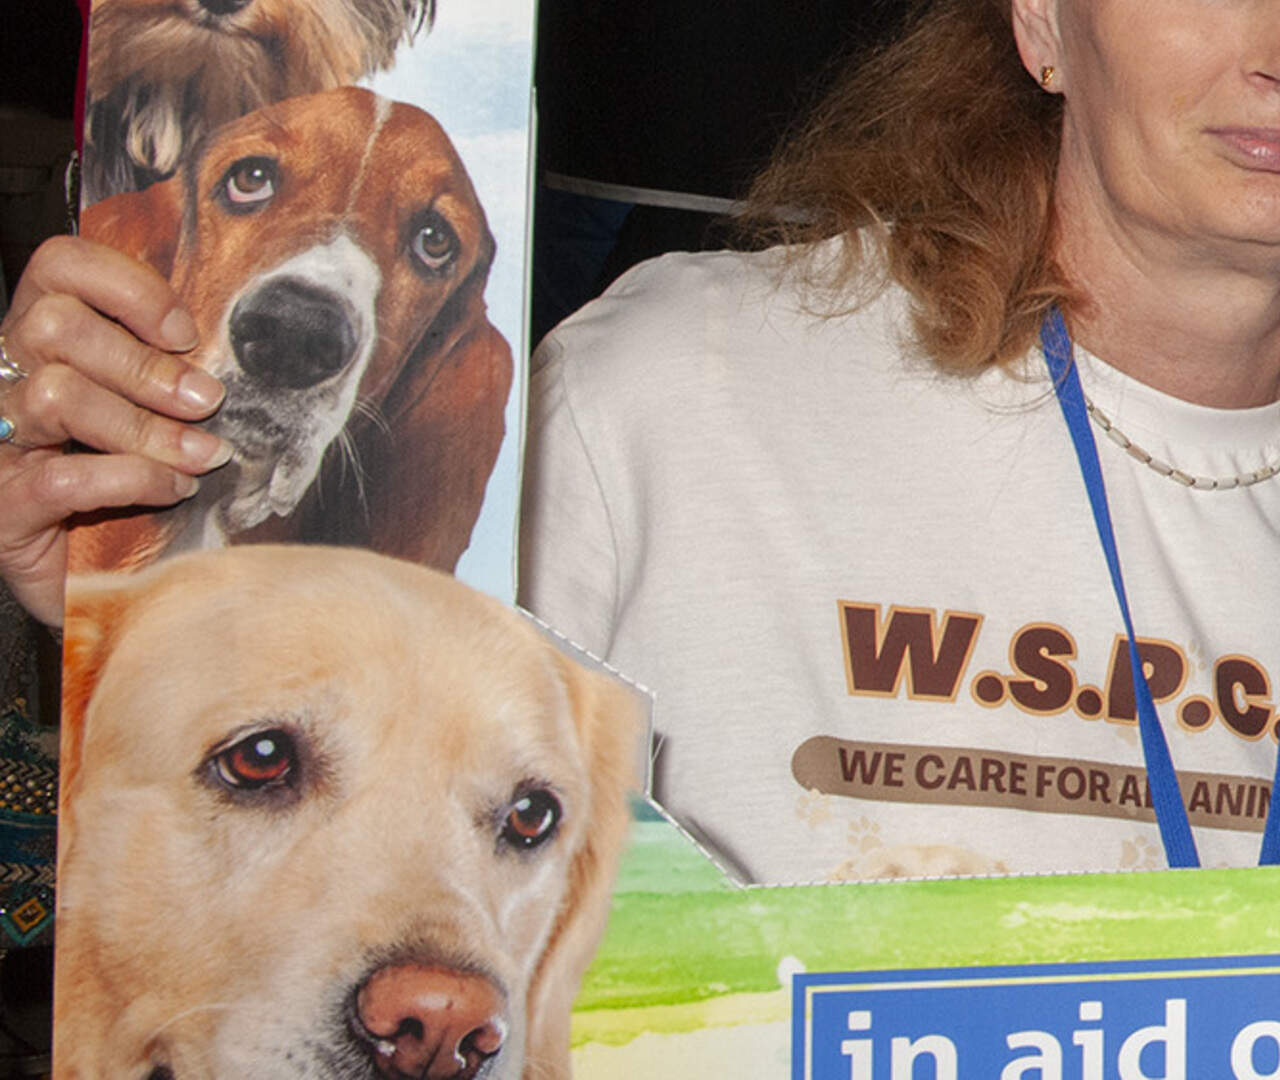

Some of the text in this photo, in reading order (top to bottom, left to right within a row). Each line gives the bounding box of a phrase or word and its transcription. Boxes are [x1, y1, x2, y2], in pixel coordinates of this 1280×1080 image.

[838, 747, 905, 787] WE
[914, 754, 1027, 796] CARE
[1035, 765, 1112, 805] FOR
[841, 1010, 957, 1080] in
[1001, 998, 1187, 1080] aid
